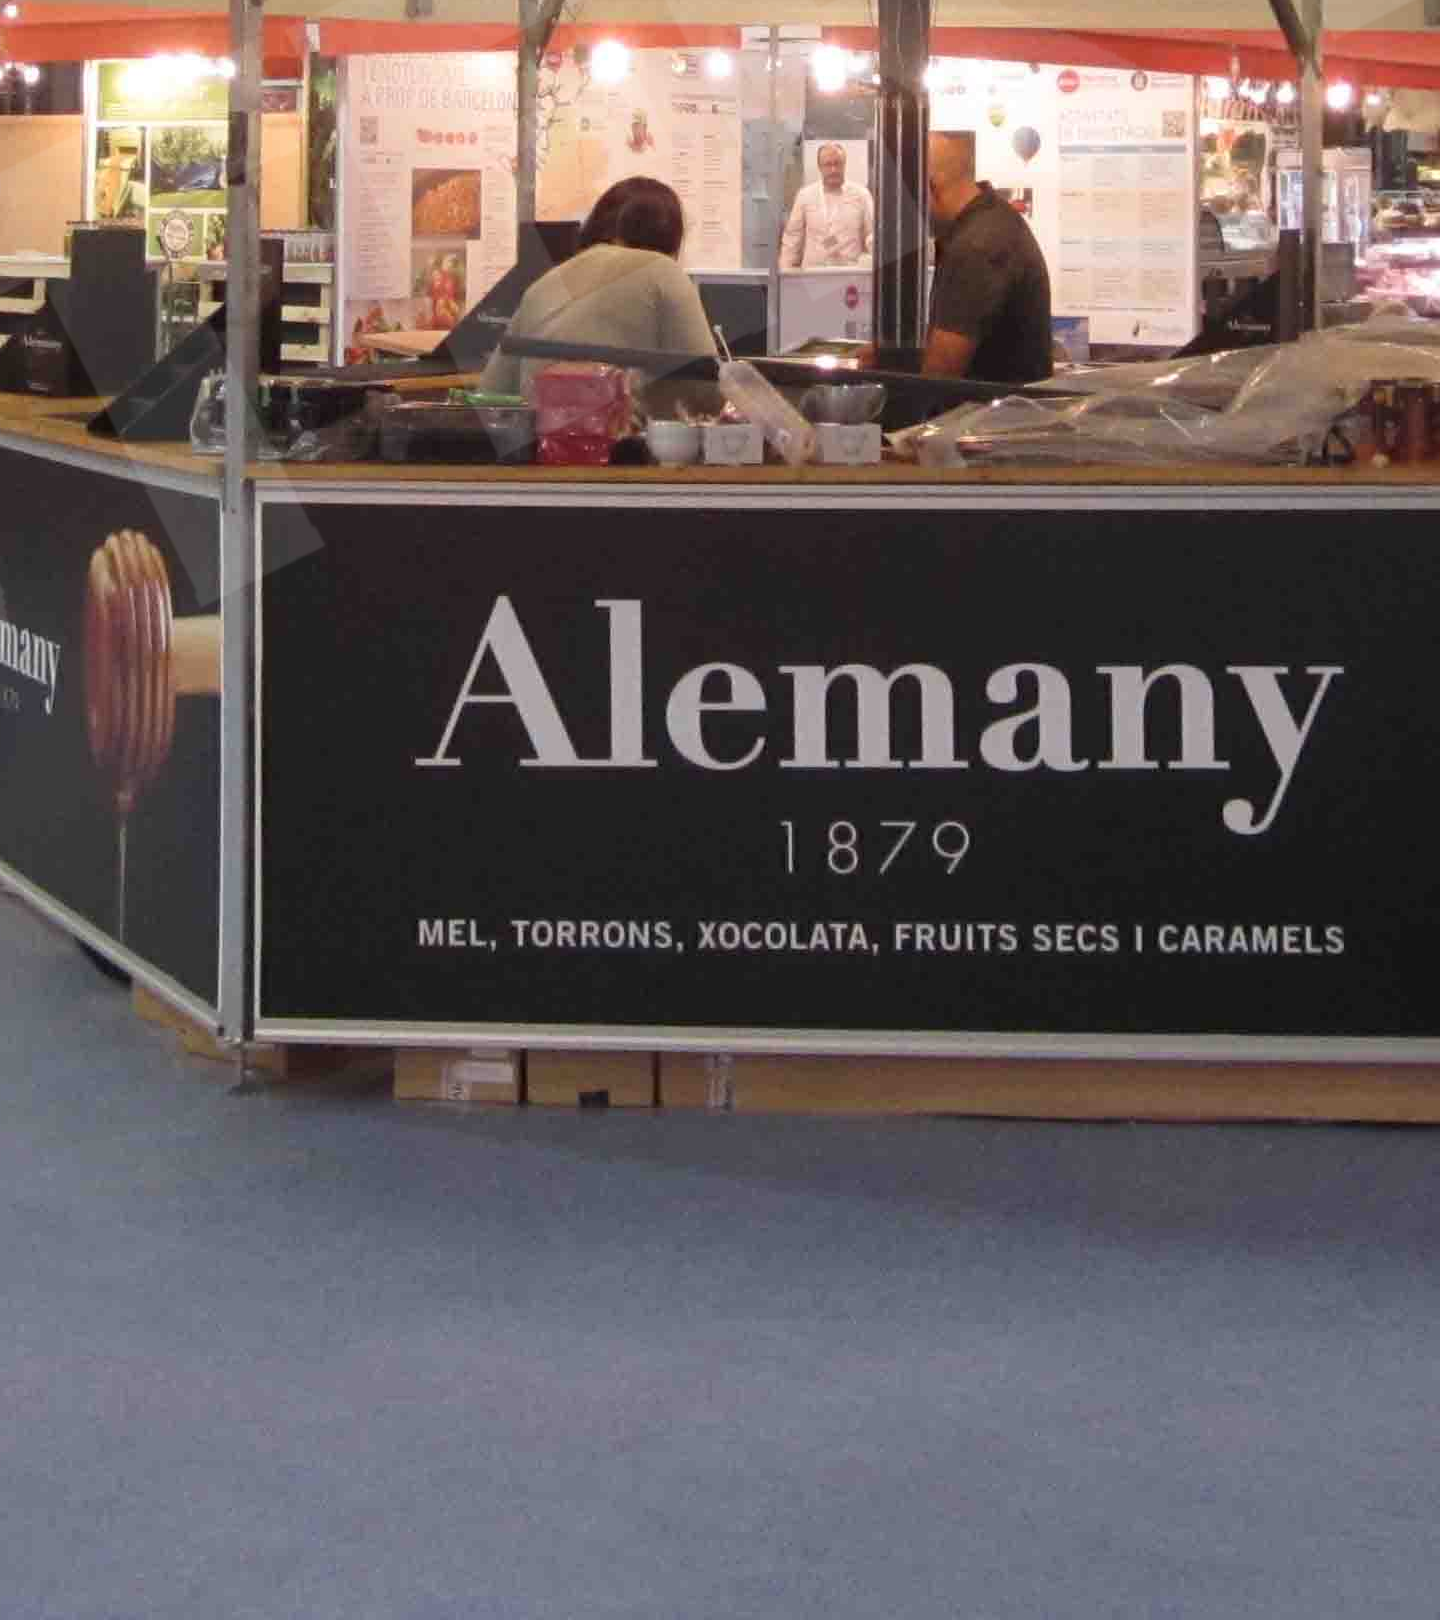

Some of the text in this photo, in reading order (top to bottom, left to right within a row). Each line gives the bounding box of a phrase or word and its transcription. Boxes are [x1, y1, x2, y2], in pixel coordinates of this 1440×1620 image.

[415, 595, 1345, 835] Alemany
[780, 820, 971, 875] 1879
[418, 919, 1345, 956] MEL, TORRONS, XOCOLATA, FRUITS SECS I CARAMELS
